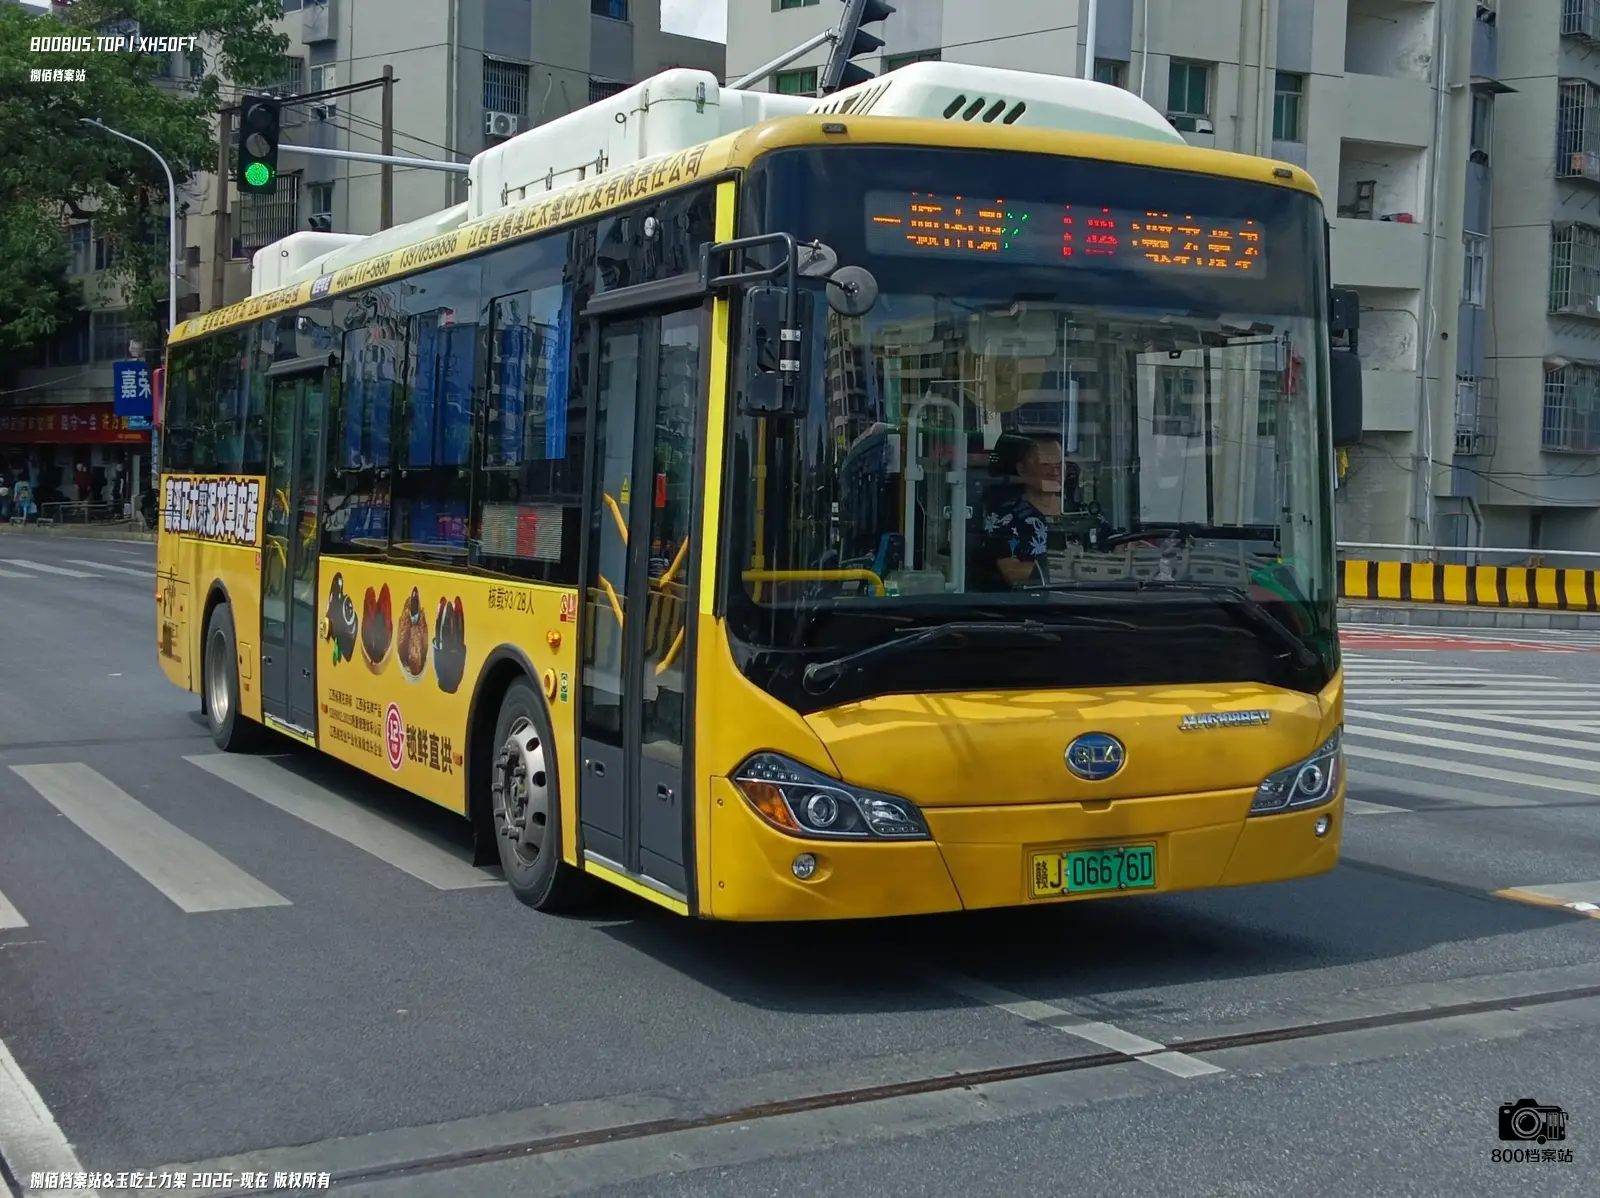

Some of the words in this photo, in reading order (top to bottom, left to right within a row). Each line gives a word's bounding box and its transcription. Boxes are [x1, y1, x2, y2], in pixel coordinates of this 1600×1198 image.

[406, 723, 453, 776] 锁鲜直供
[1073, 850, 1153, 886] 06676D
